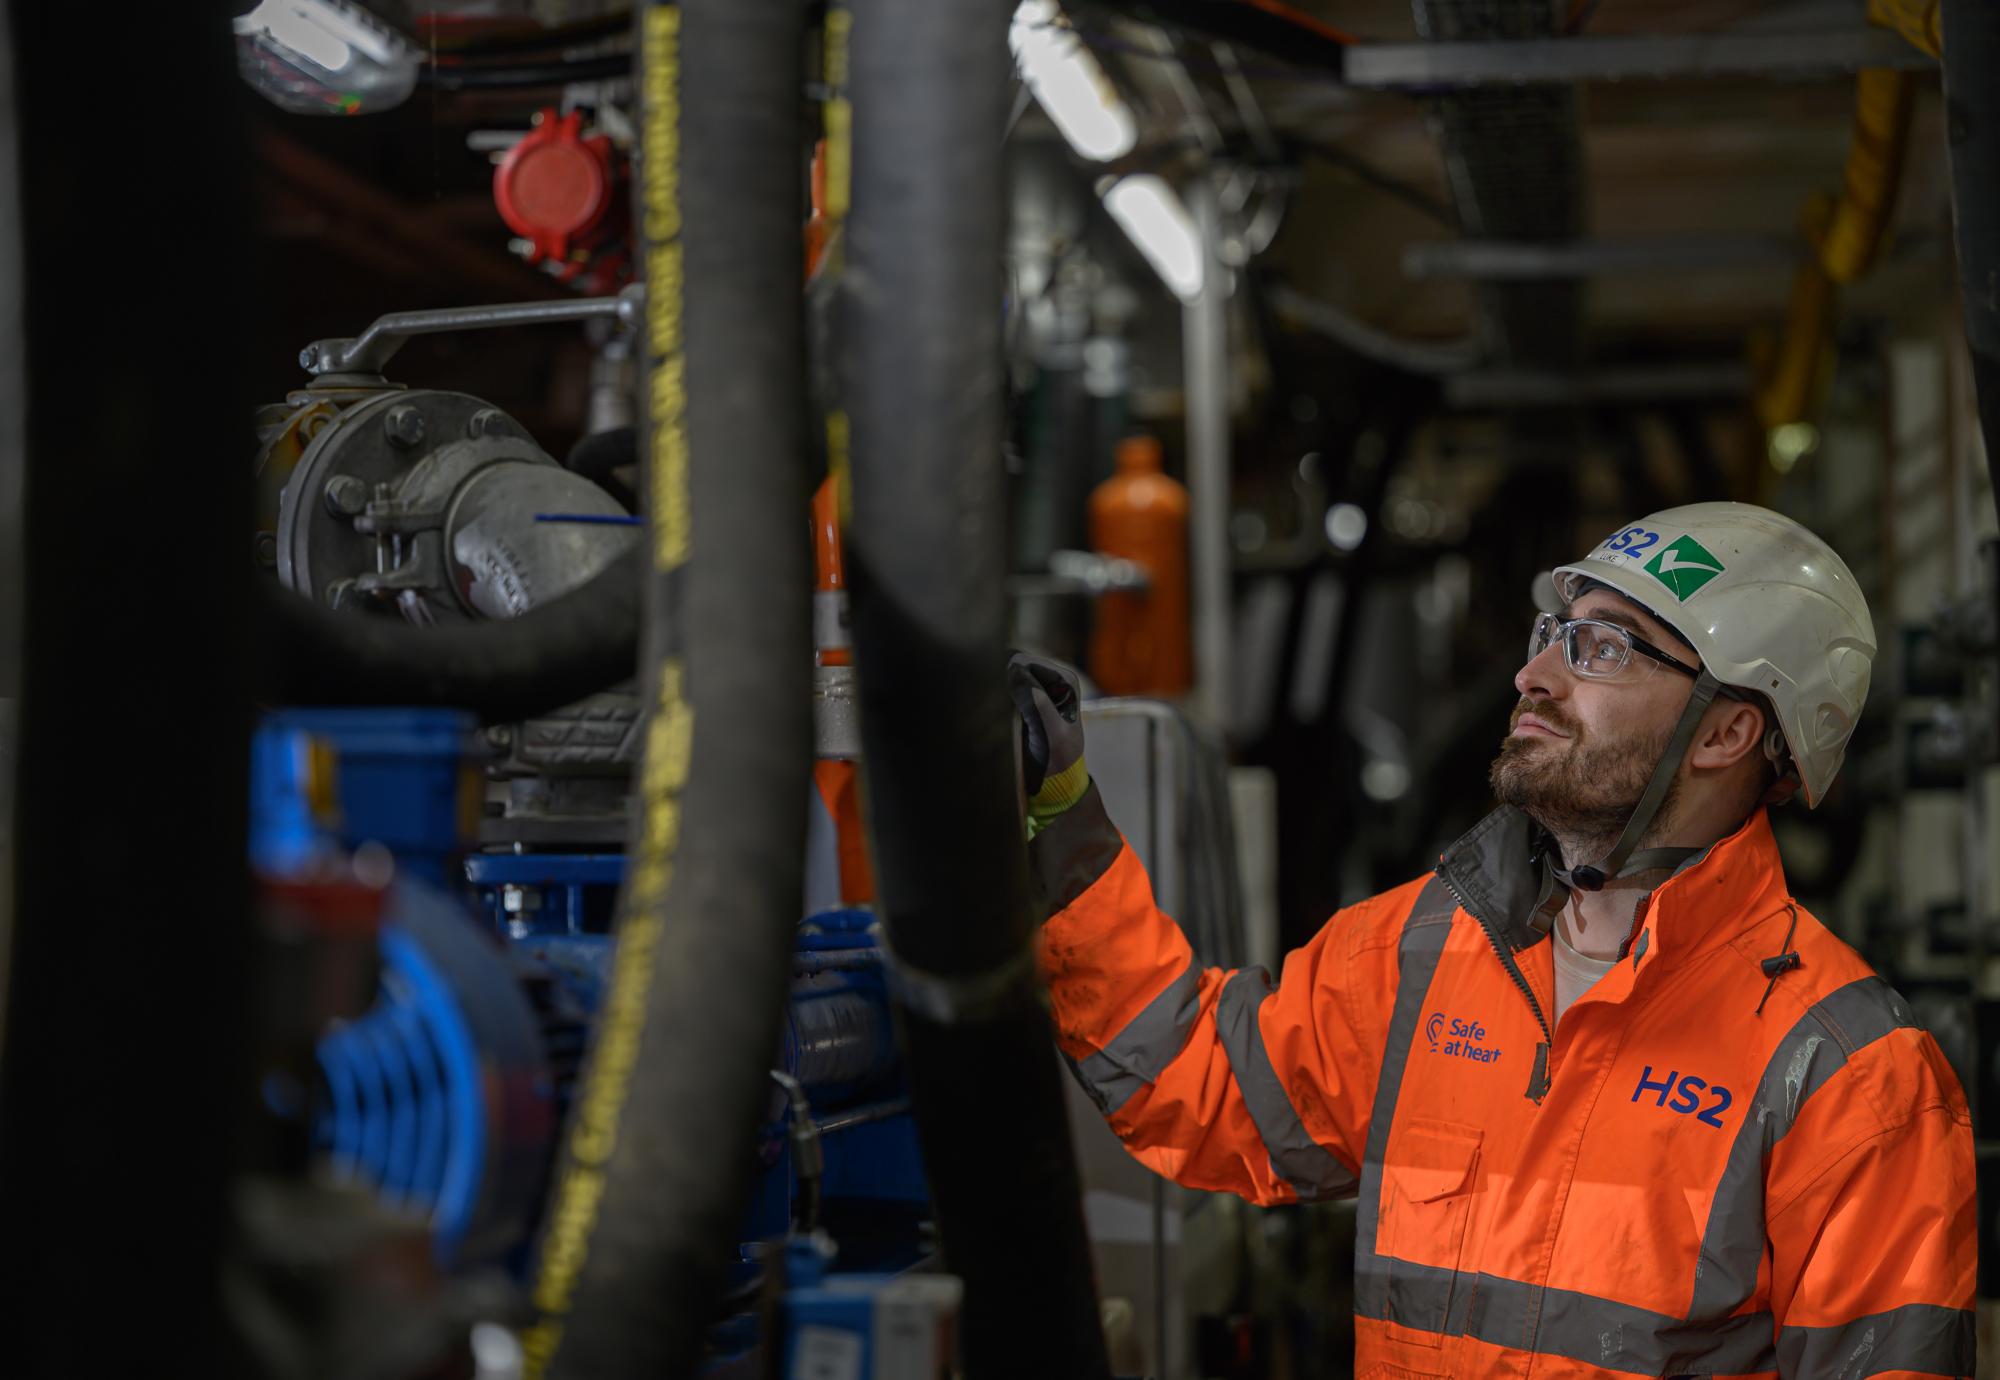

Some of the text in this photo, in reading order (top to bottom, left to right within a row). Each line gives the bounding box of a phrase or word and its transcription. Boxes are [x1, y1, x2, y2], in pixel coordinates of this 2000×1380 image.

[1449, 1018, 1485, 1041] Safe
[1443, 1040, 1502, 1063] at heart
[1632, 1066, 1733, 1129] HS2
